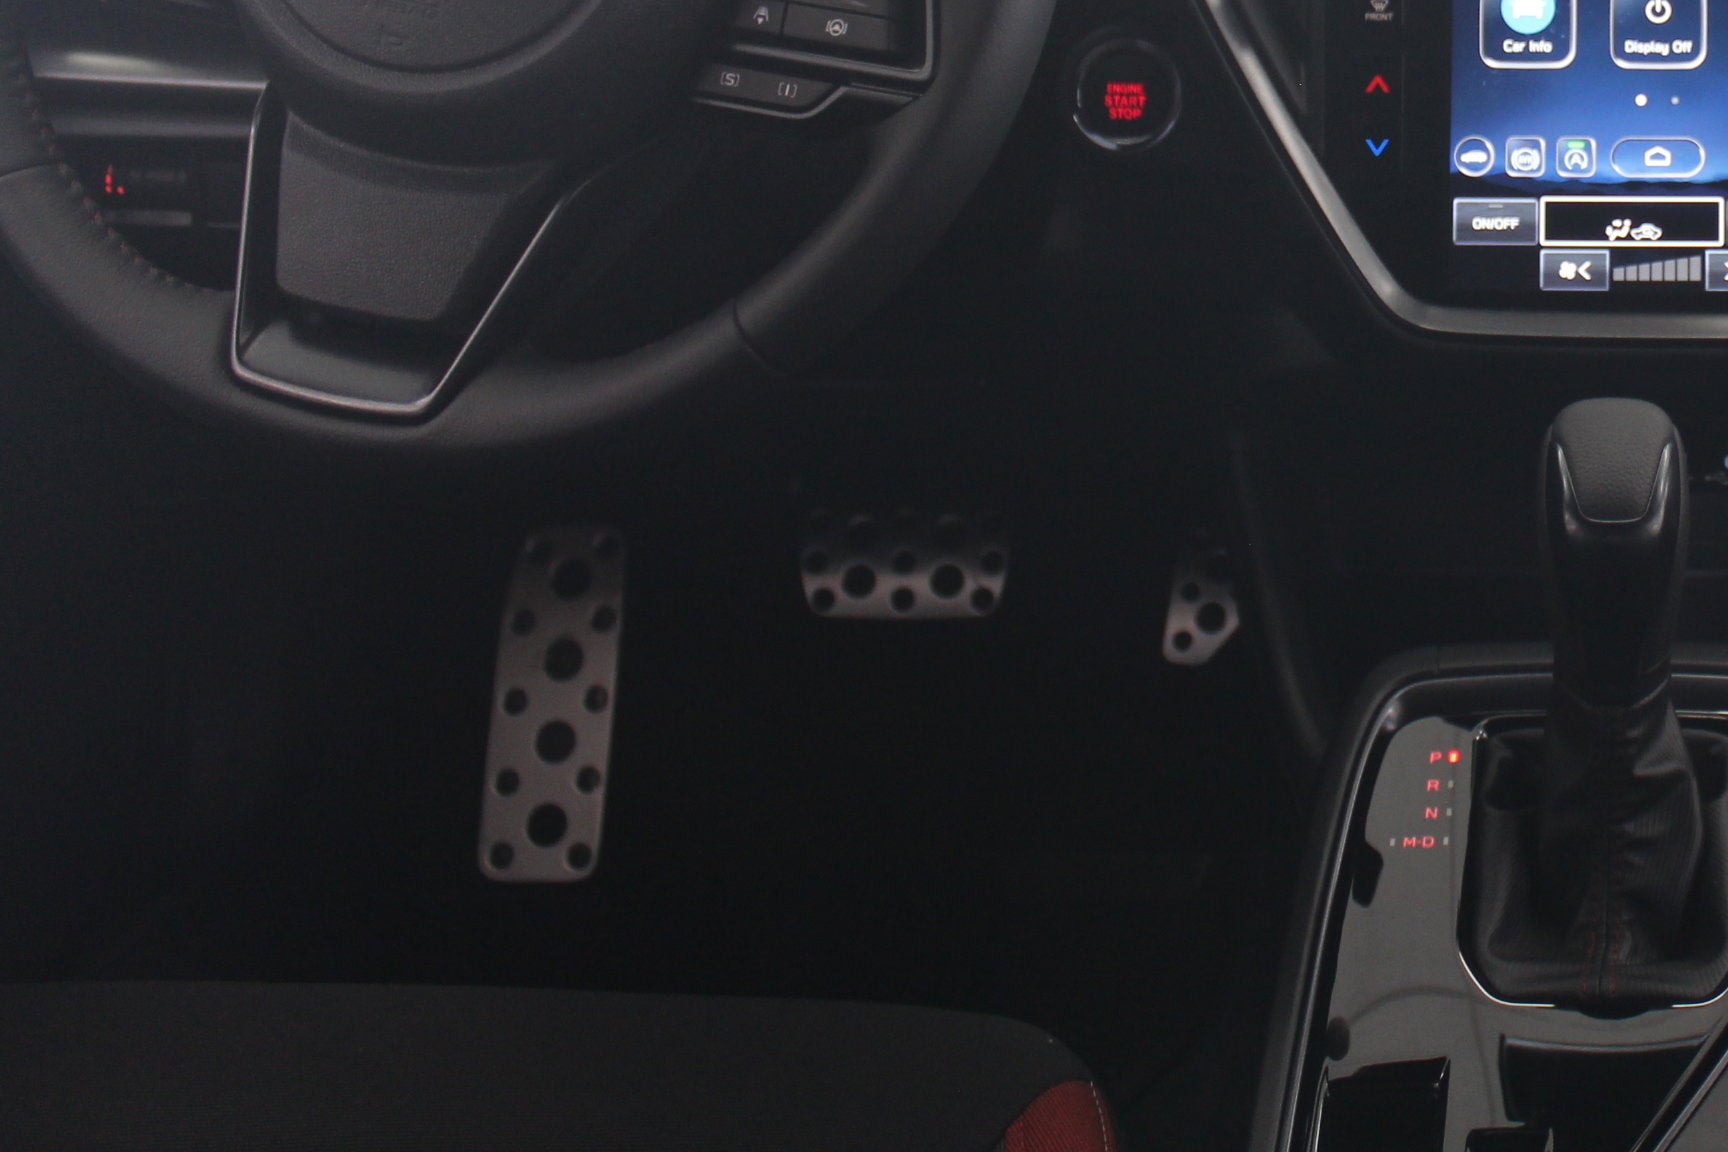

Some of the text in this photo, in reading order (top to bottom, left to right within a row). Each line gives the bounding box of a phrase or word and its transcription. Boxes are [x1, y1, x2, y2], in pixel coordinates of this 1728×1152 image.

[1365, 12, 1394, 22] FRONT
[1503, 39, 1552, 53] Car Info
[1624, 40, 1693, 55] Display Off
[1106, 82, 1145, 94] ENGINE
[1104, 94, 1147, 107] START
[1109, 107, 1142, 120] STOP
[1472, 217, 1520, 231] ON/OFF
[1430, 751, 1442, 764] P
[1427, 779, 1439, 791] R
[1425, 807, 1438, 819] N
